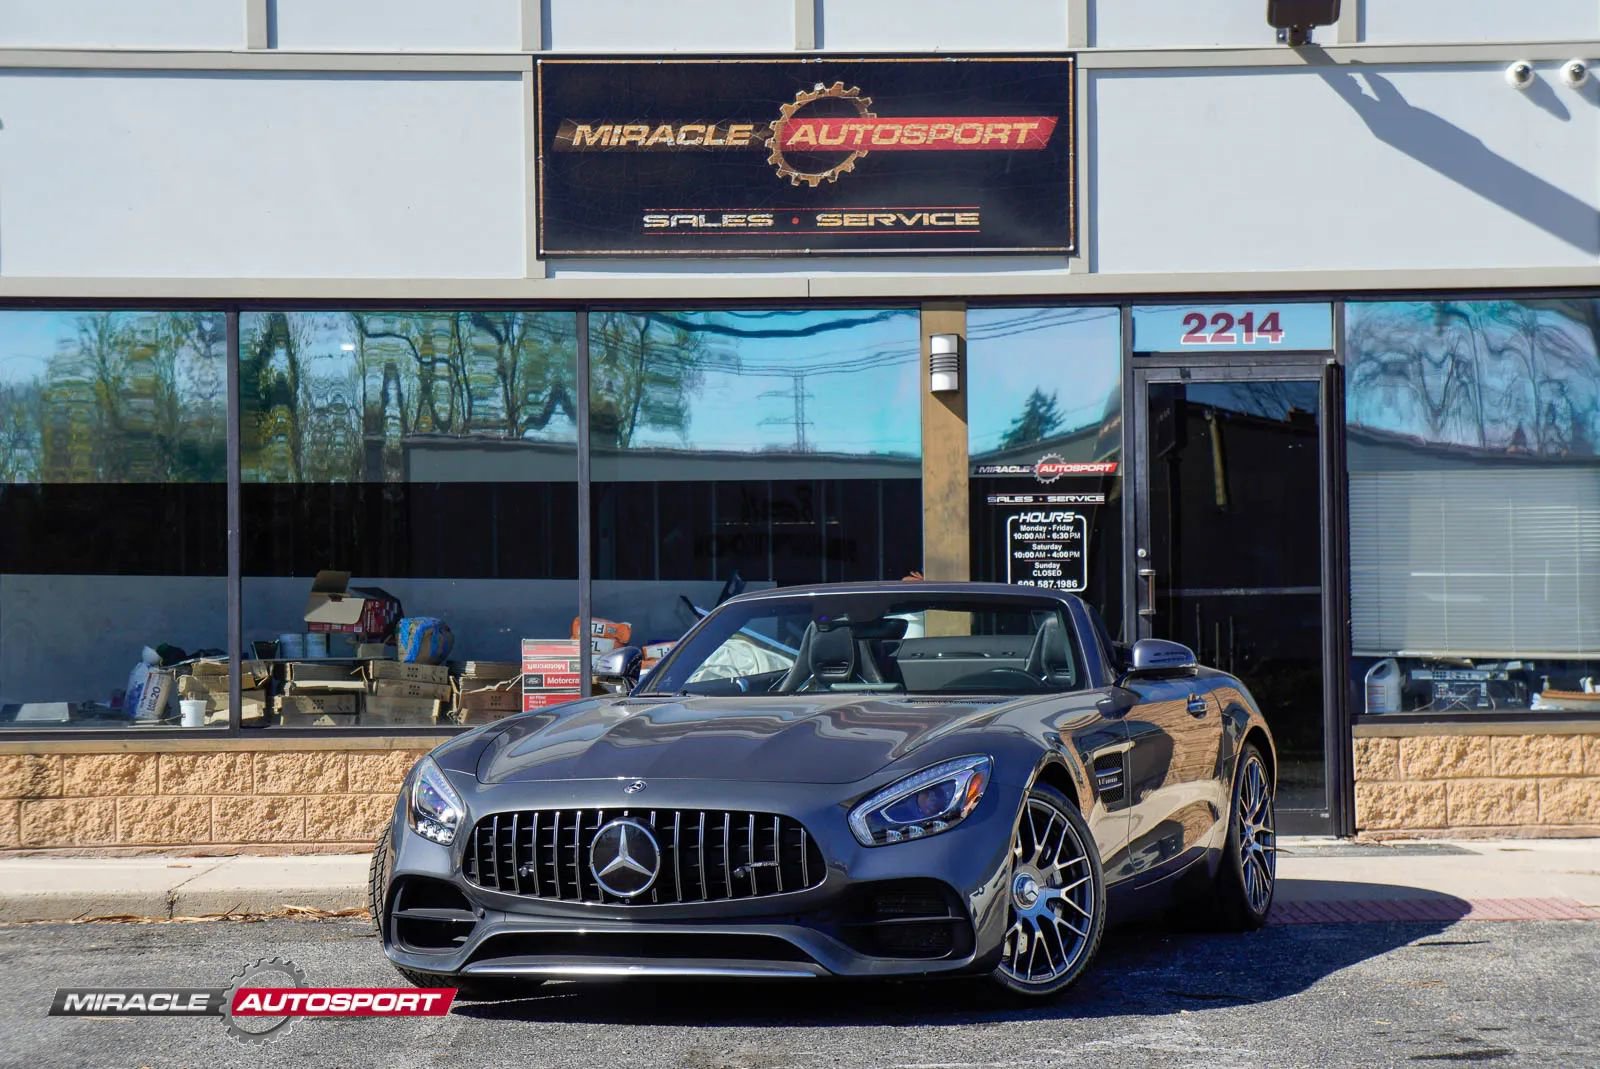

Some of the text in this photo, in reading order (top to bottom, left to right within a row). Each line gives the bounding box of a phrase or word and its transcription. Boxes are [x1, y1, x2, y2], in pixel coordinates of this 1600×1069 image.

[572, 122, 1039, 147] MIRACLE AUTOSPORT
[642, 212, 980, 229] SALES SERVICE
[1180, 311, 1285, 345] 2214
[978, 463, 1113, 474] MIRACLE AUTOSPORT
[1047, 495, 1105, 503] SERVICE
[1019, 512, 1075, 523] HOURS
[1020, 524, 1047, 532] Monday
[1052, 524, 1074, 532] Friday
[1032, 543, 1063, 551] Saturday
[1032, 569, 1063, 577] CLOSED
[1017, 580, 1078, 588] 609587.1986
[527, 662, 566, 670] Motorcraft
[546, 676, 580, 685] Motorcra
